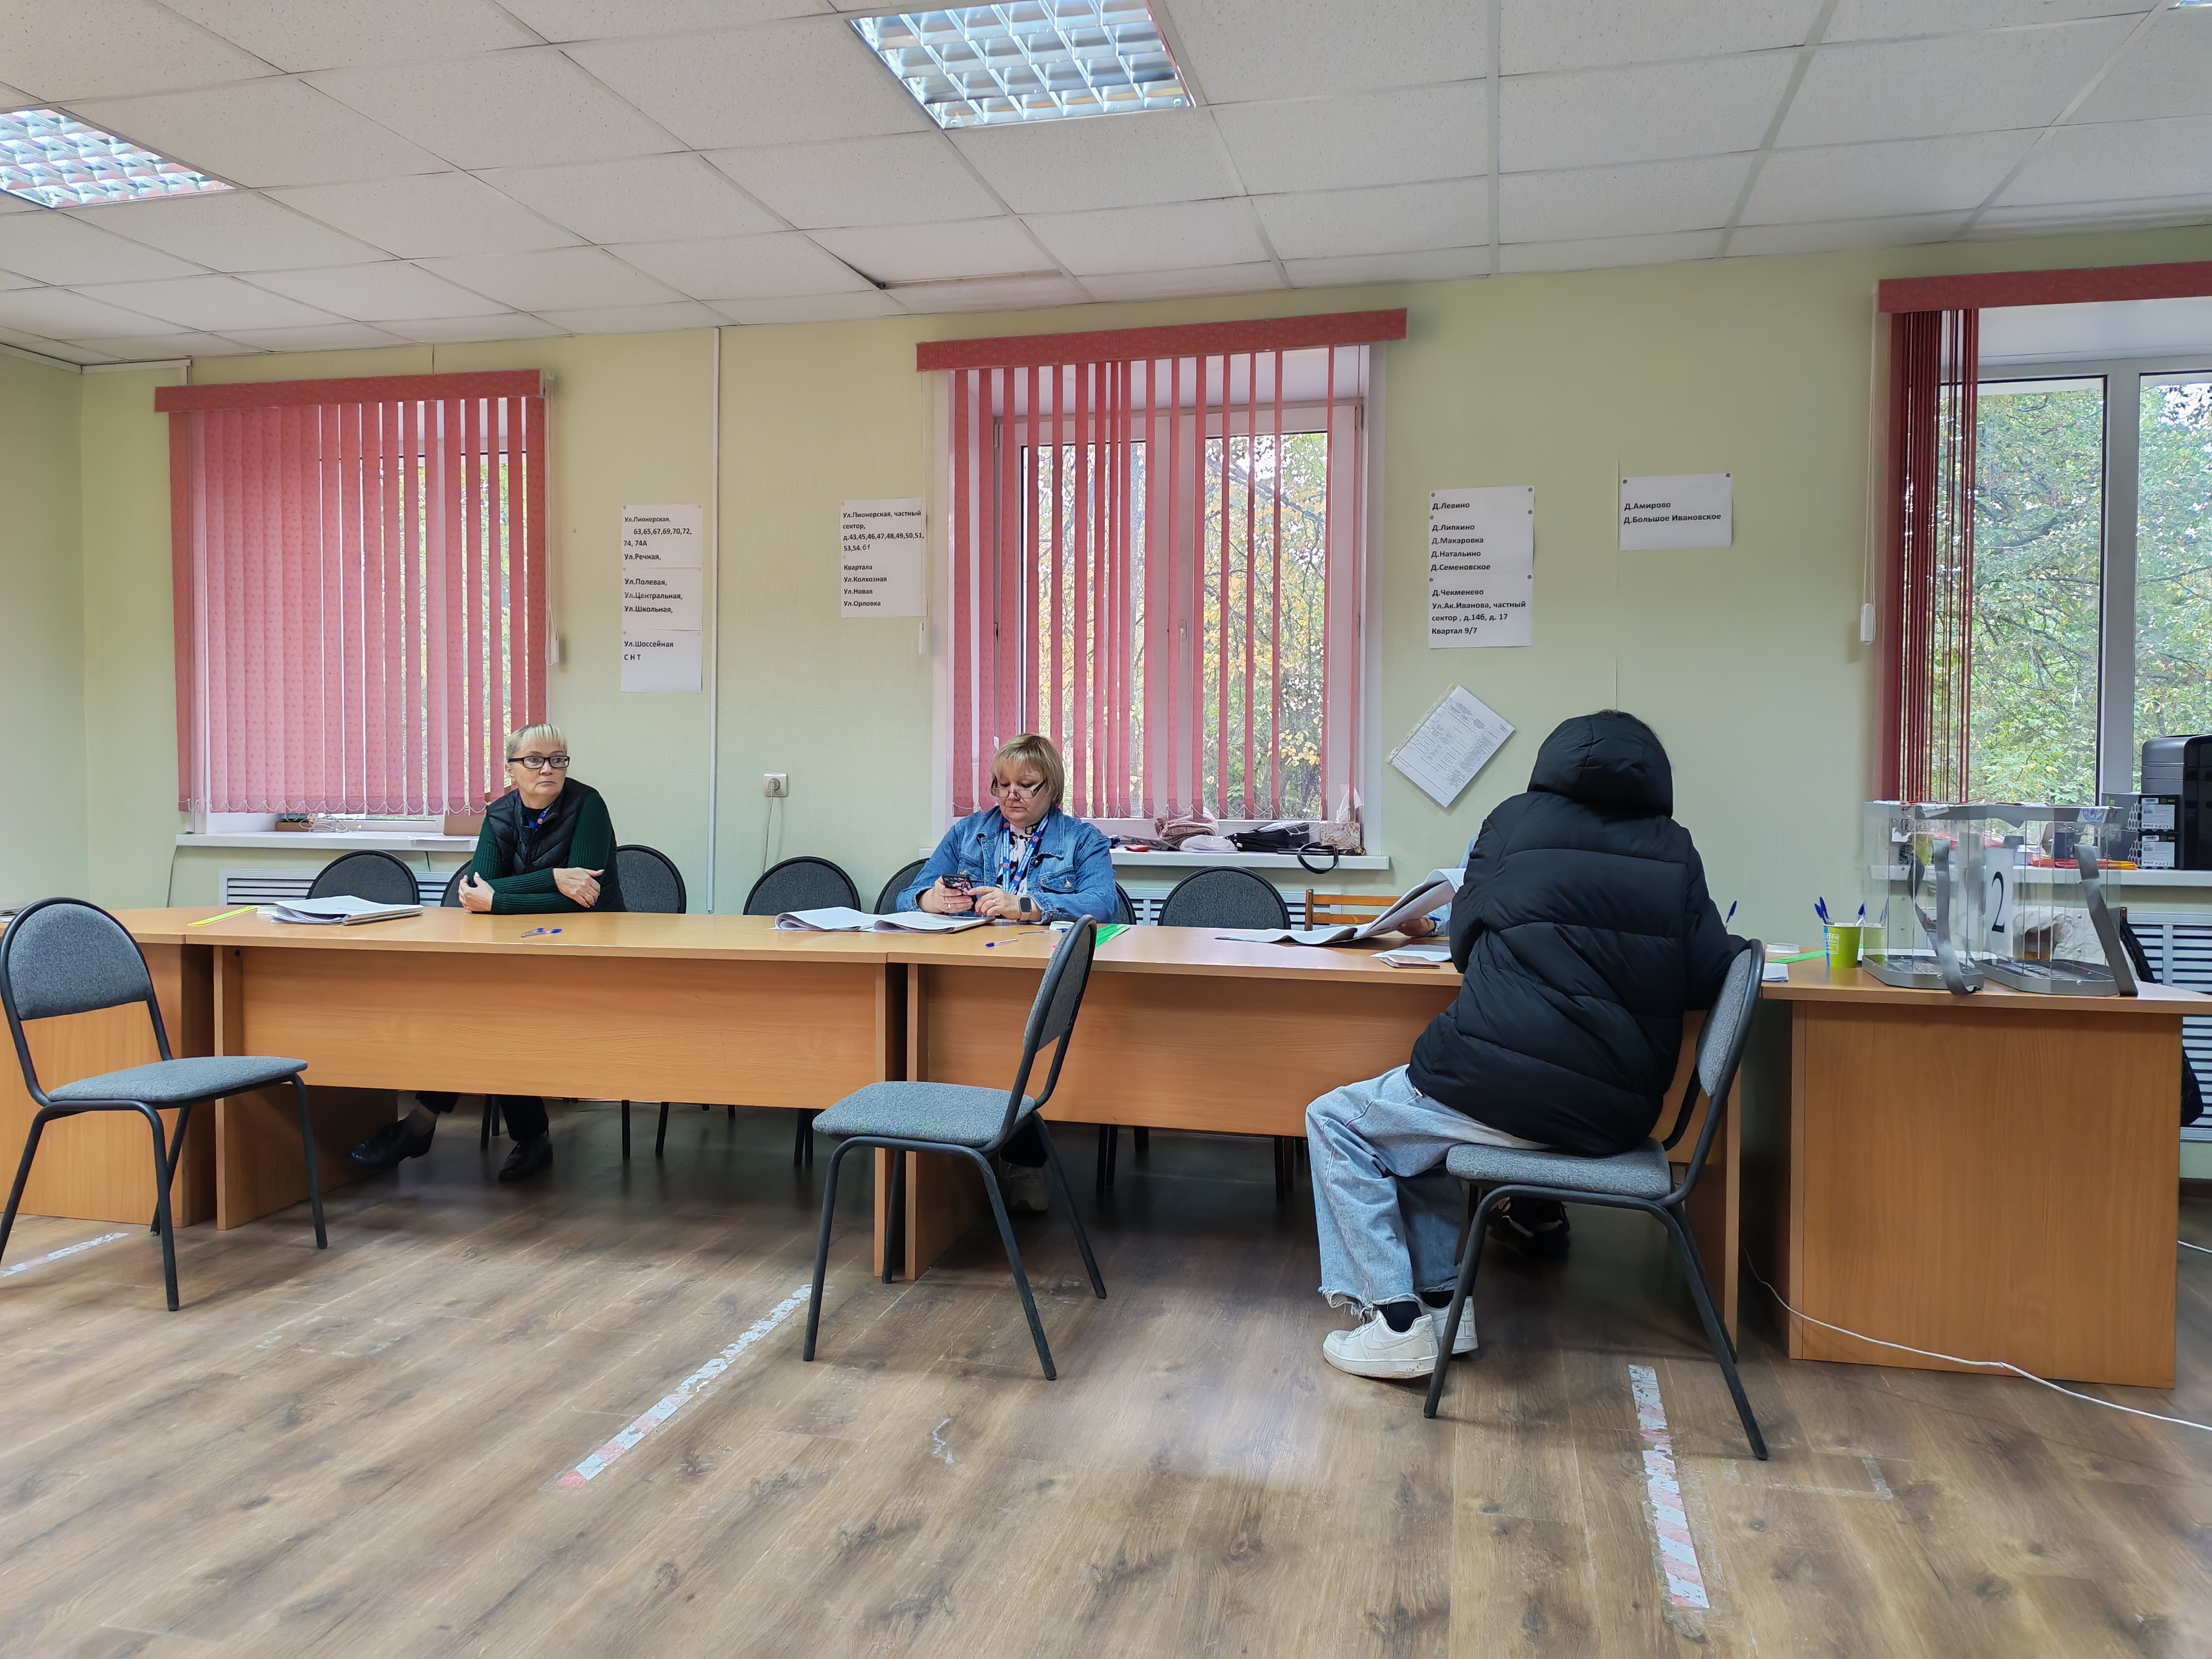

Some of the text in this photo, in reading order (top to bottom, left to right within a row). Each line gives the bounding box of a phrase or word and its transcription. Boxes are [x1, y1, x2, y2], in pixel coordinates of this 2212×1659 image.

[1432, 502, 1470, 510] Д.Левино
[1624, 502, 1671, 511] Д.Амирово
[1623, 516, 1670, 525] Д.Большое
[633, 528, 692, 536] 63,65,67,69,70,72,
[842, 532, 925, 542] д.43,45,46,47,48,49,50,51,
[1431, 537, 1484, 545] Д.Макаровка
[1431, 550, 1481, 558] Д.Натальино
[1430, 563, 1491, 572] Д.Семеновское
[624, 578, 667, 586] Ул.Полевая,
[624, 591, 683, 599] Ул.Центральная,
[1432, 589, 1484, 597] Д.Чекменево
[624, 605, 673, 613] Ул.Школьная,
[1431, 626, 1478, 636] Квартал 9/7
[1991, 871, 2005, 934] 2
